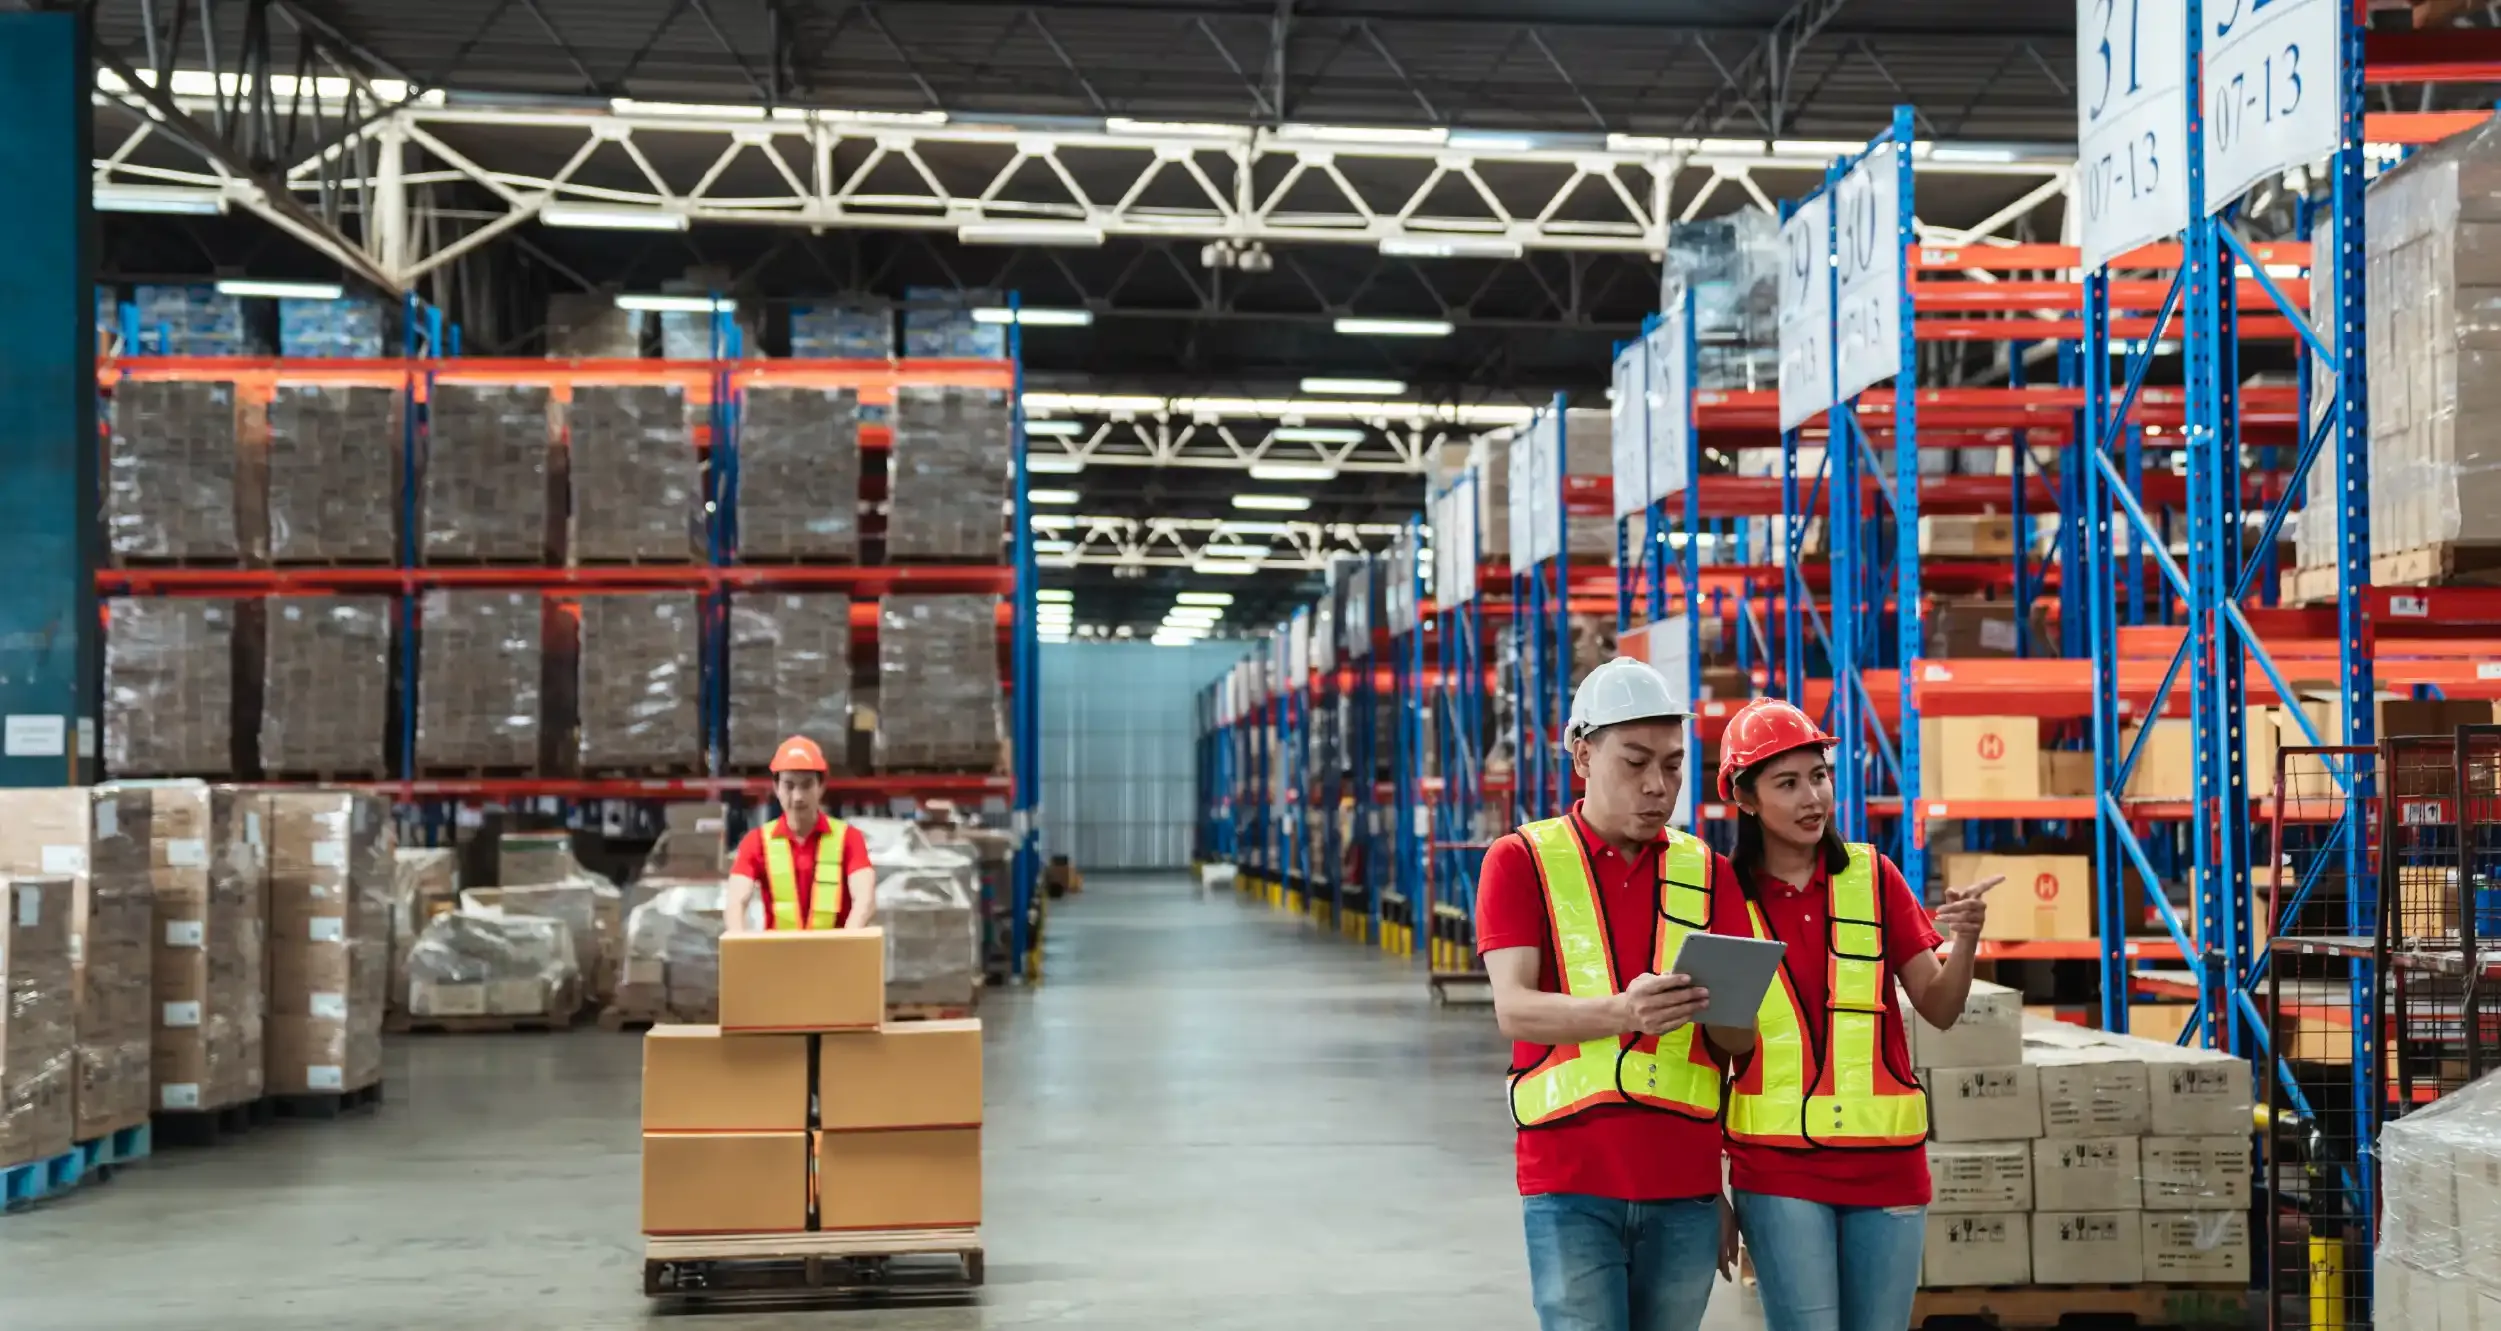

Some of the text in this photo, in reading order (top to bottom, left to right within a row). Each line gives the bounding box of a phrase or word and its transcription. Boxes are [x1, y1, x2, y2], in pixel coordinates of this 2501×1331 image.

[2090, 0, 2143, 121] 31
[2216, 43, 2302, 153] 07-13
[2089, 131, 2159, 221] 07-13
